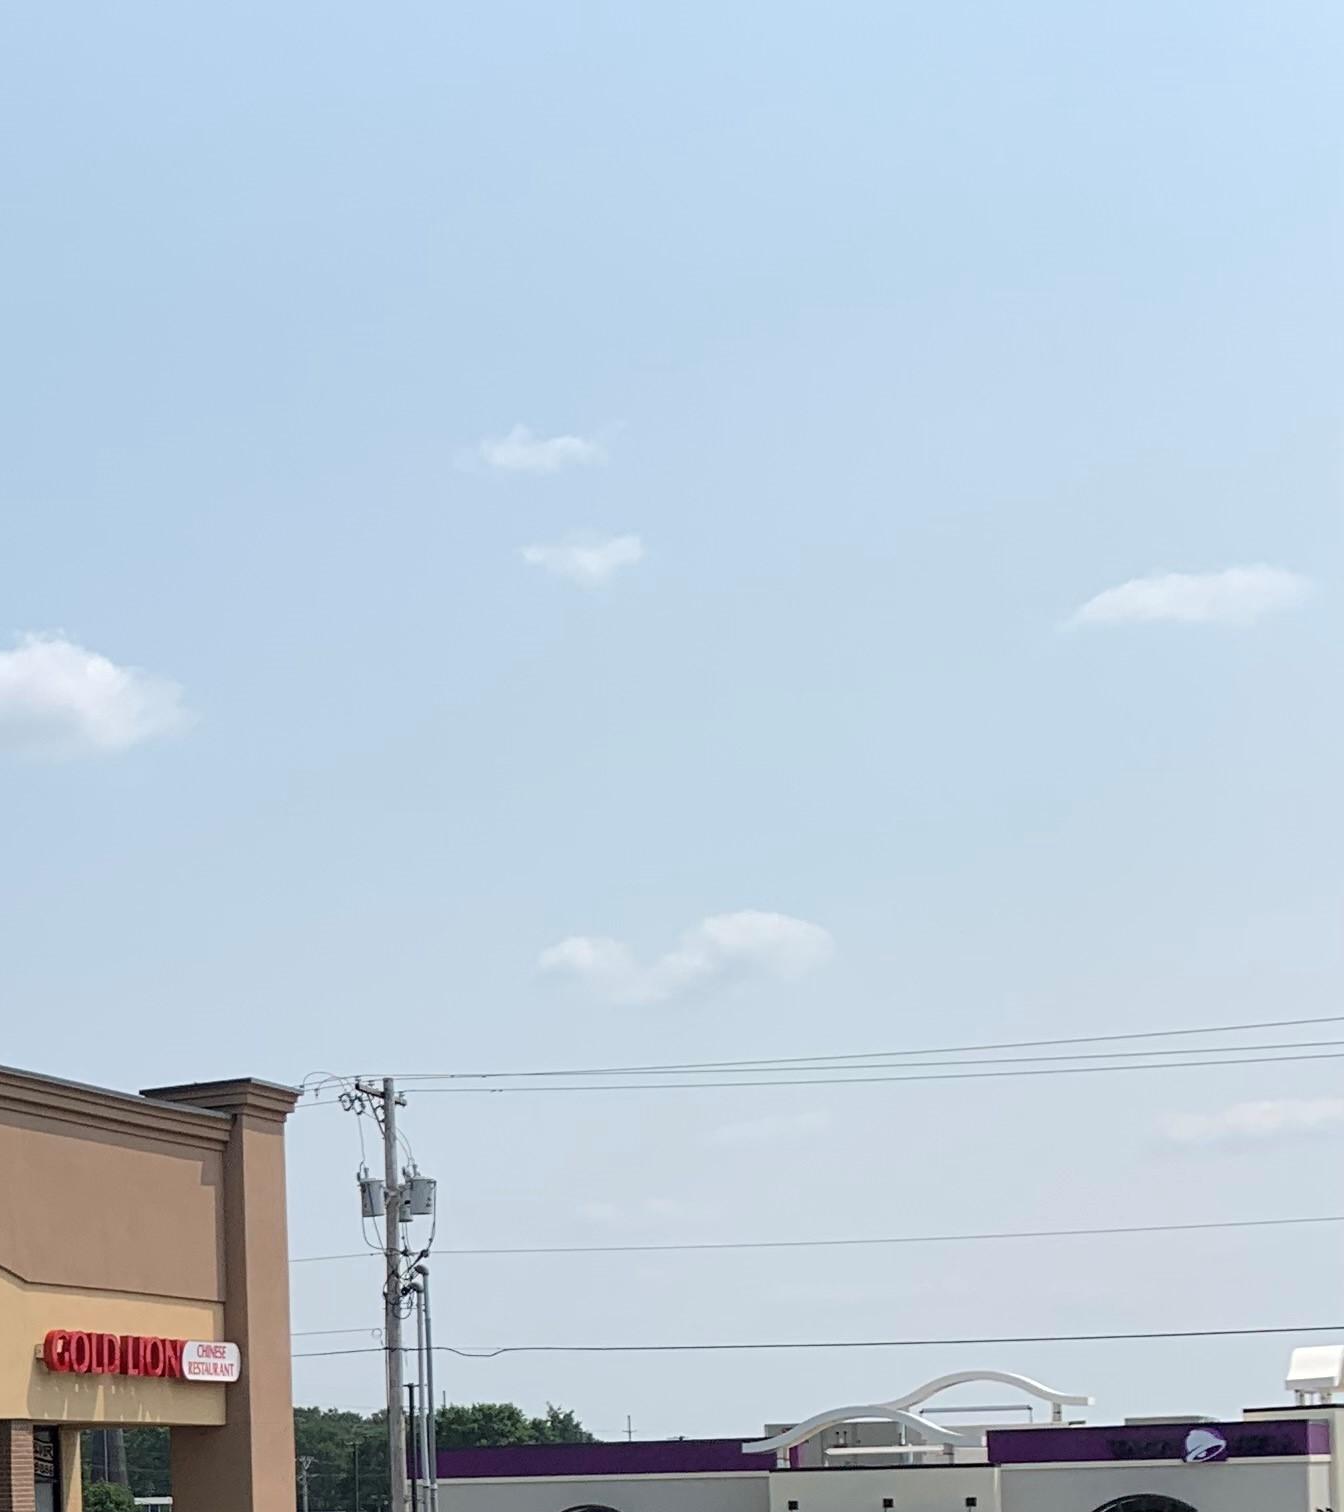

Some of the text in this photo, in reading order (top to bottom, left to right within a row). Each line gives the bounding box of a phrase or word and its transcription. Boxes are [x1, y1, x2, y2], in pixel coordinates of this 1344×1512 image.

[44, 1330, 181, 1378] GOLD LION
[197, 1343, 227, 1359] CHINESE
[188, 1361, 234, 1377] RESTAURANT
